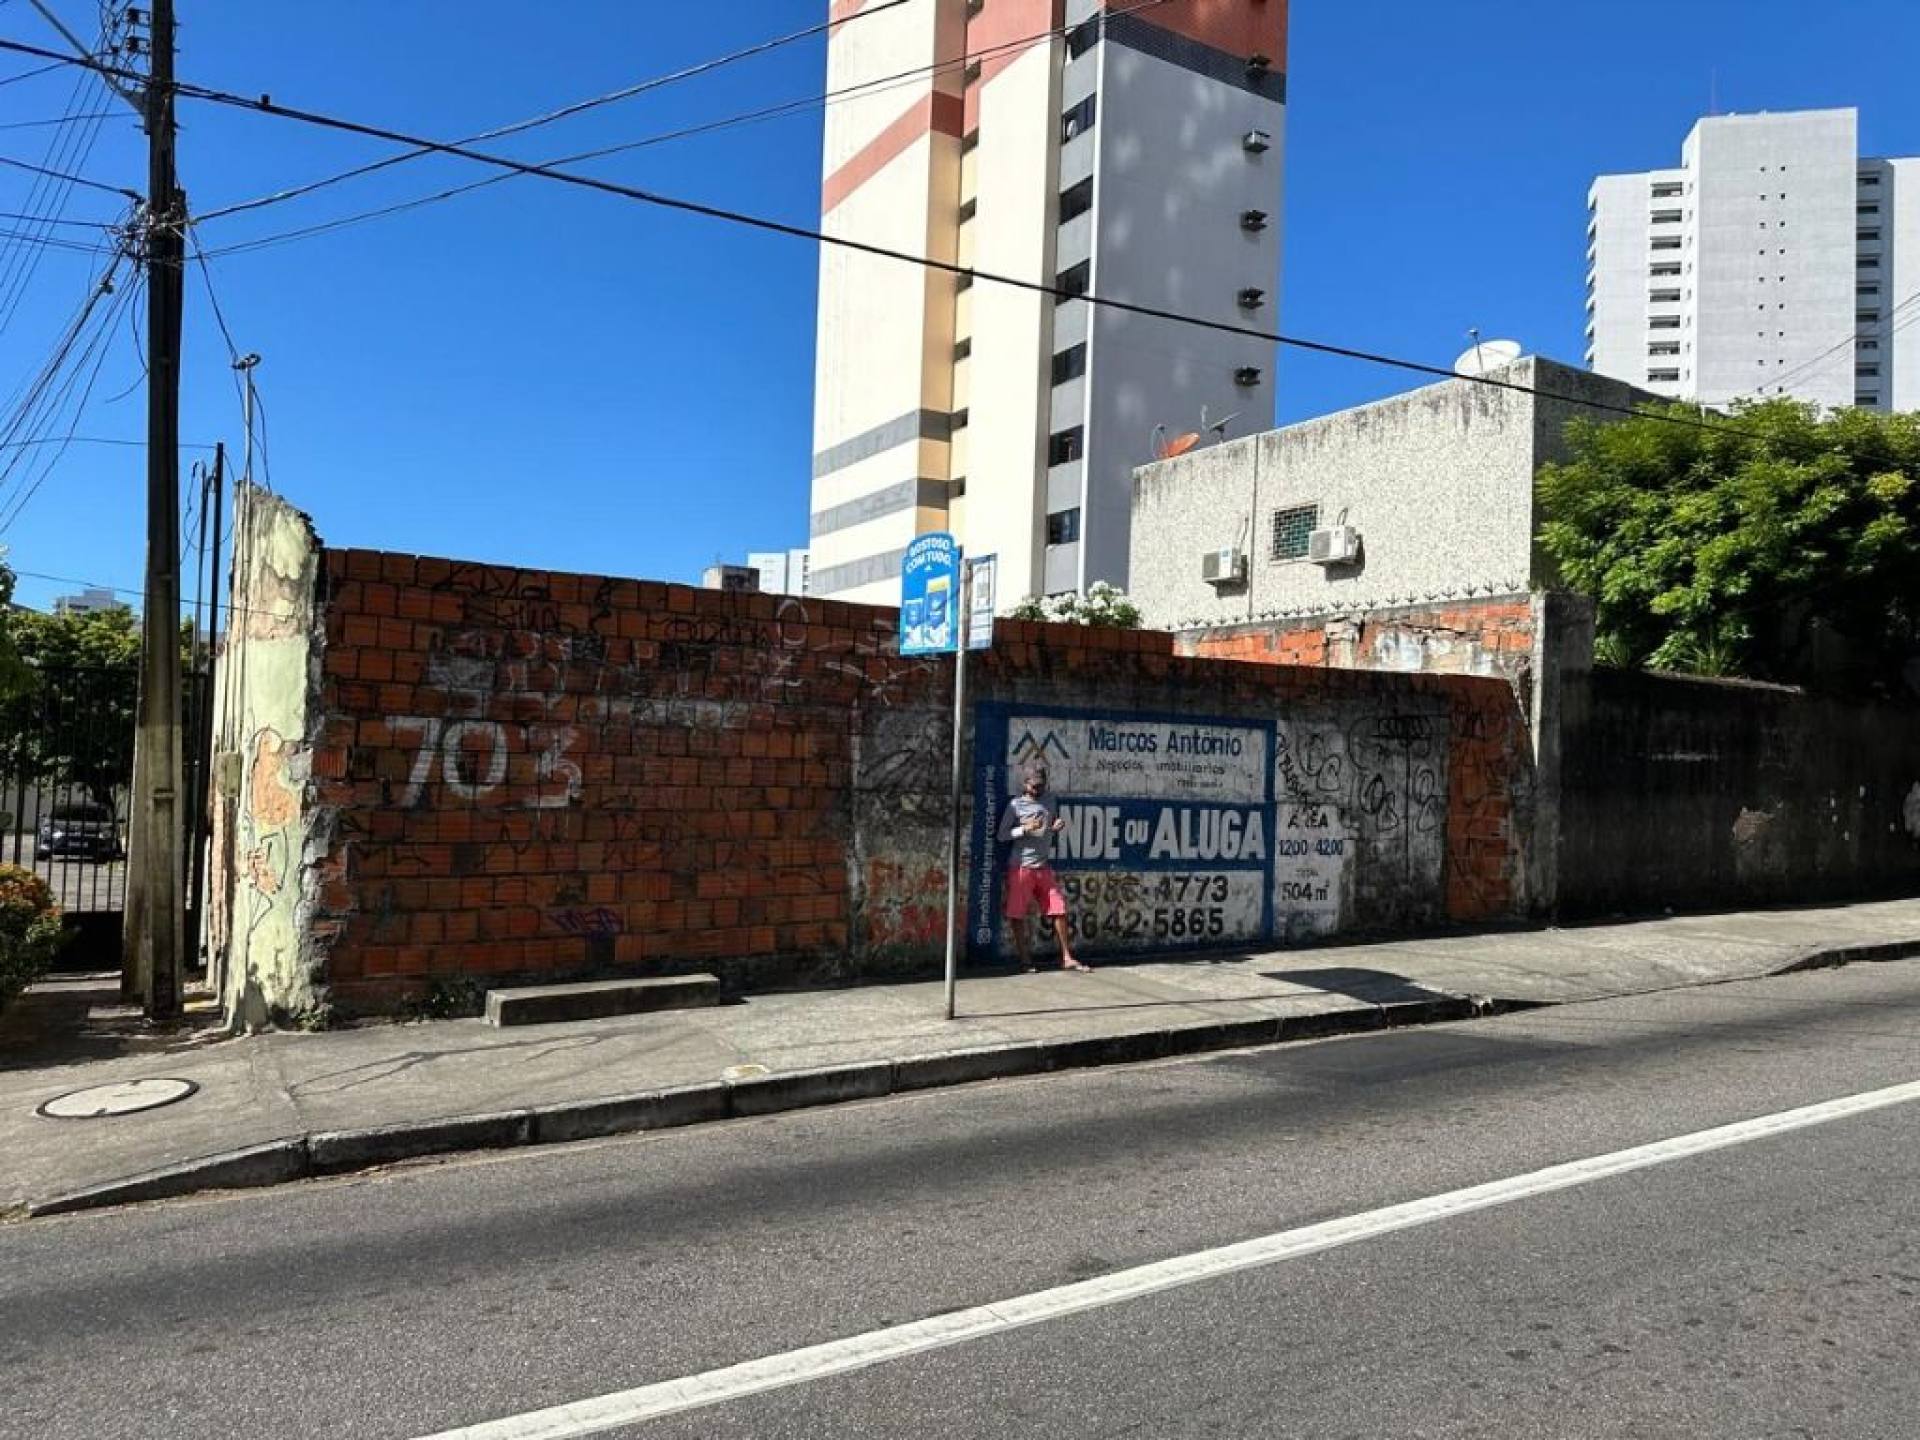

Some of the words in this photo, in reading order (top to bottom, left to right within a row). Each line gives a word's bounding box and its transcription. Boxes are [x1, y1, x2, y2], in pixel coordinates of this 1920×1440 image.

[1088, 726, 1157, 753] Marcos
[1149, 807, 1265, 861] ALUGA
[1279, 839, 1308, 856] 1200
[1281, 882, 1312, 901] 504
